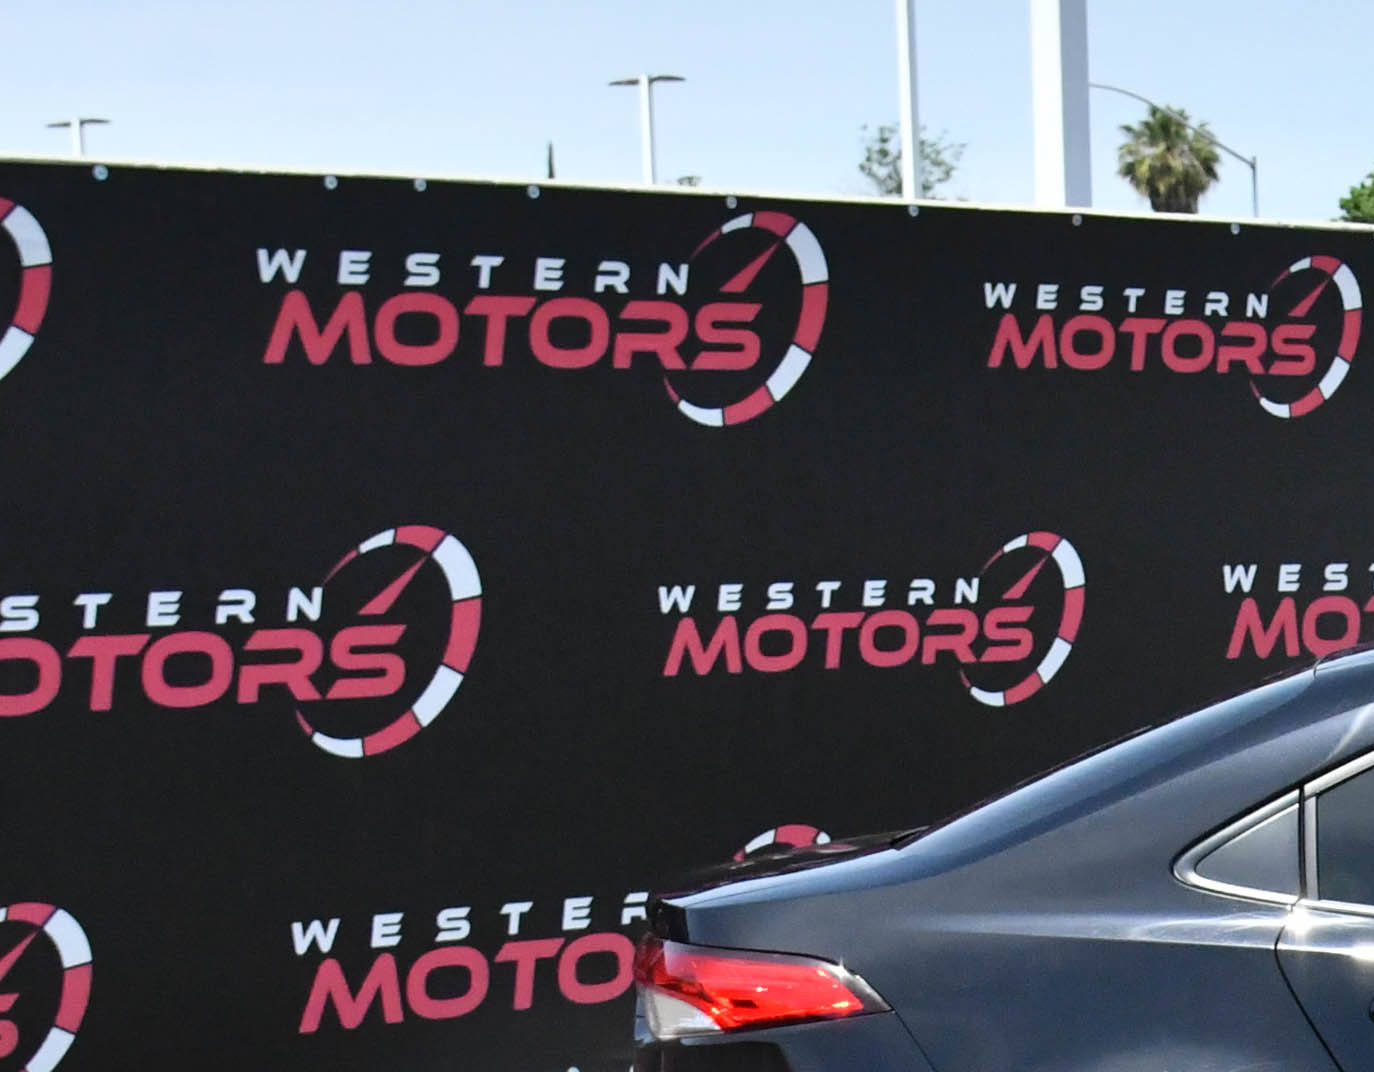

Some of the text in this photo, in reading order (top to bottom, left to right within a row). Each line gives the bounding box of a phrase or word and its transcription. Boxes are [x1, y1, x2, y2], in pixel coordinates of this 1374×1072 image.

[257, 248, 689, 295] WESTERN
[984, 282, 1268, 318] WESTERN
[263, 290, 762, 371] MOTORS
[988, 313, 1317, 376] MOTORS
[0, 586, 323, 632] STERN
[658, 577, 980, 614] WESTERN
[663, 606, 1035, 677] MOTORS
